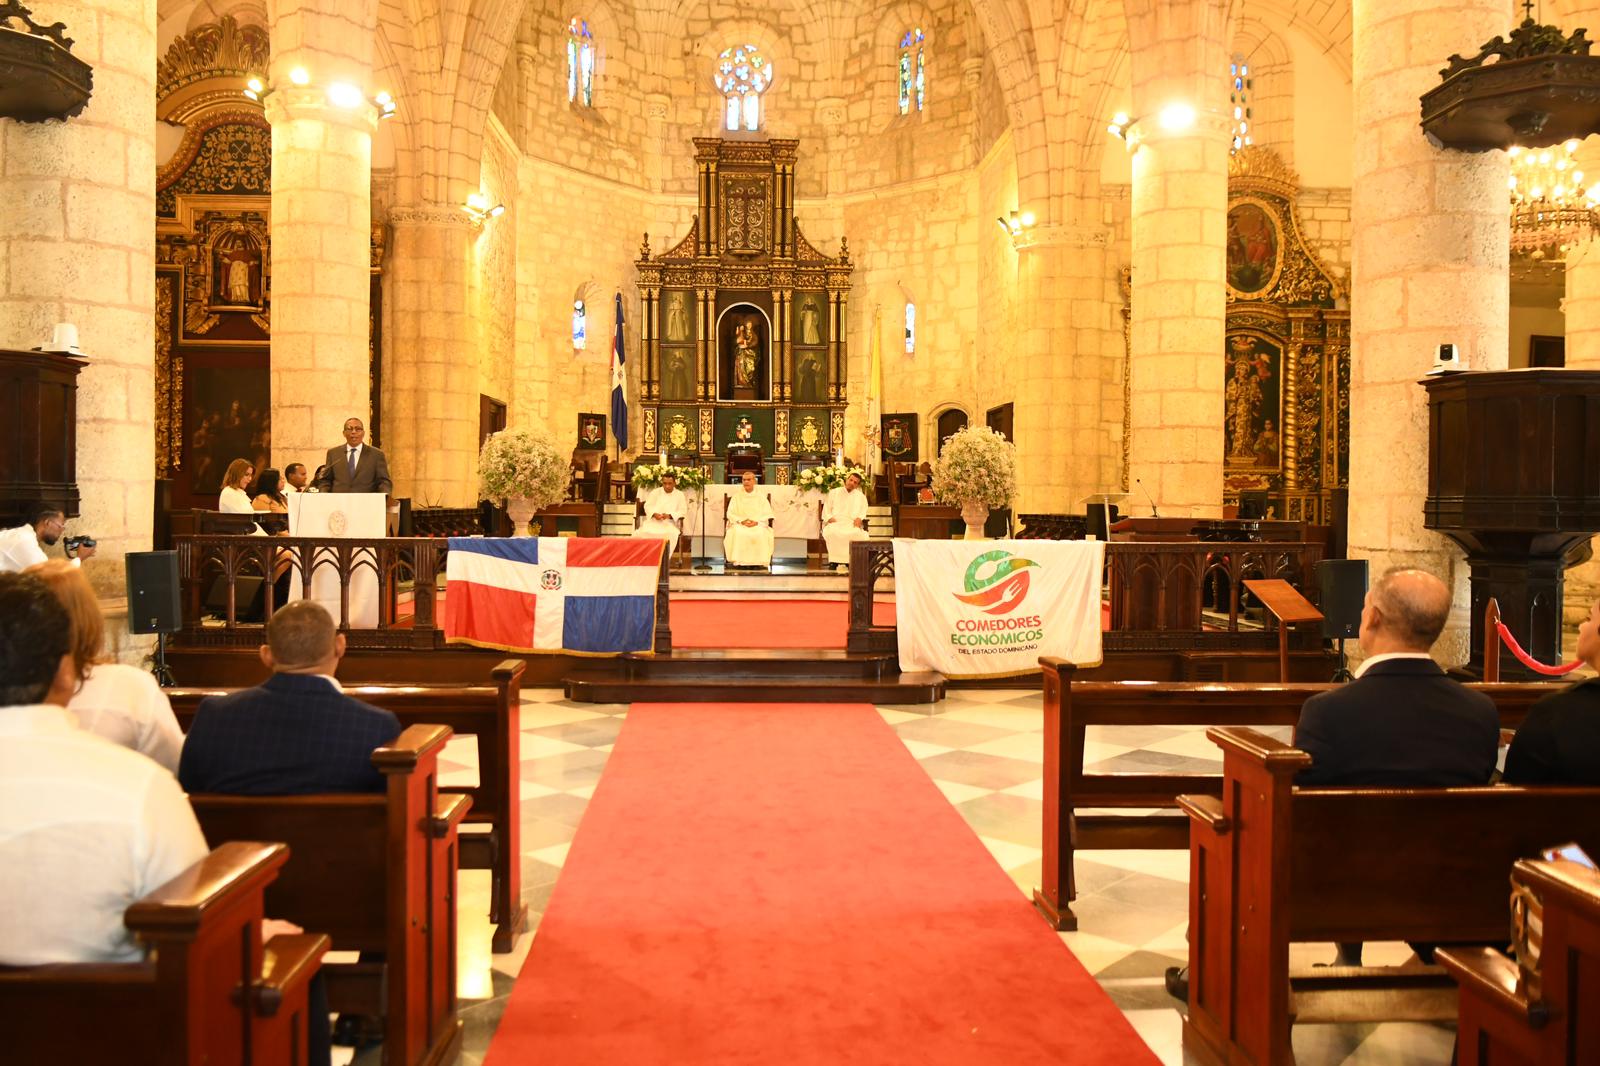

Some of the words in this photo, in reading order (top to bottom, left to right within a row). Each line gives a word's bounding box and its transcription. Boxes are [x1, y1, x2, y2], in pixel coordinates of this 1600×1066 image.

[956, 615, 1042, 632] COMEDORES
[951, 629, 1043, 646] ECONÓMICOS
[998, 644, 1038, 654] DOMINICANO
